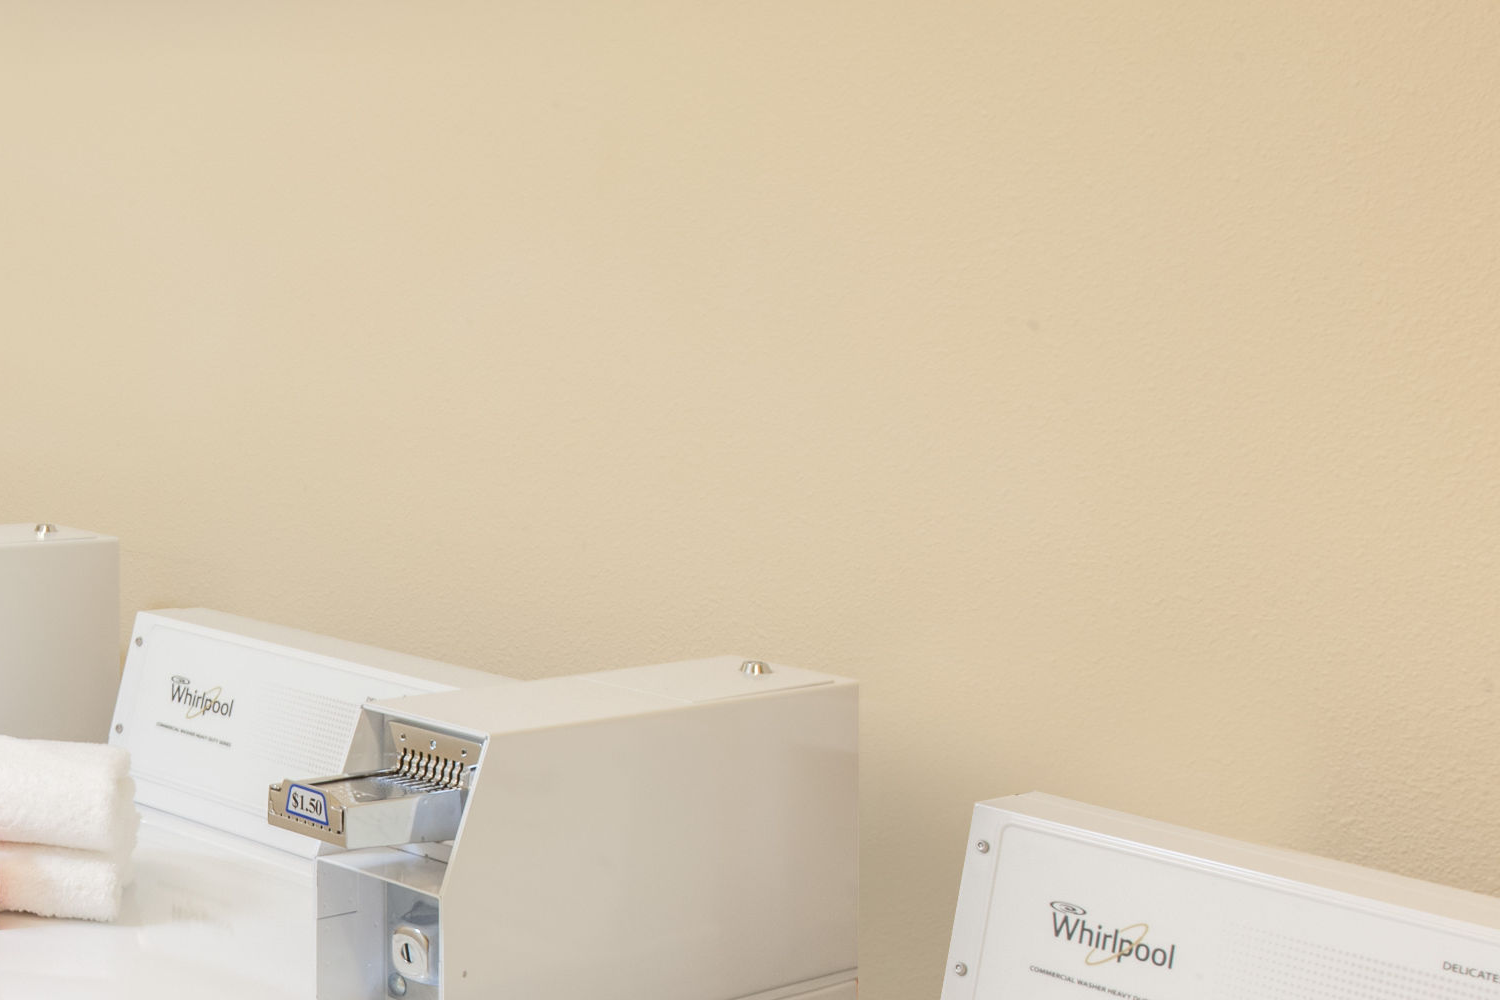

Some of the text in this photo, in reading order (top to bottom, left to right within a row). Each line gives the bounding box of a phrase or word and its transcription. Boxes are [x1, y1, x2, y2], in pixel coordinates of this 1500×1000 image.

[171, 683, 234, 718] Whirlpool
[292, 792, 323, 816] $1.50
[1052, 911, 1176, 970] Whirlpool
[1029, 965, 1075, 984] COMMERCIAL
[1077, 979, 1107, 993] WASHER
[1107, 988, 1132, 1000] HEAVY
[1442, 960, 1500, 985] DELICATE
